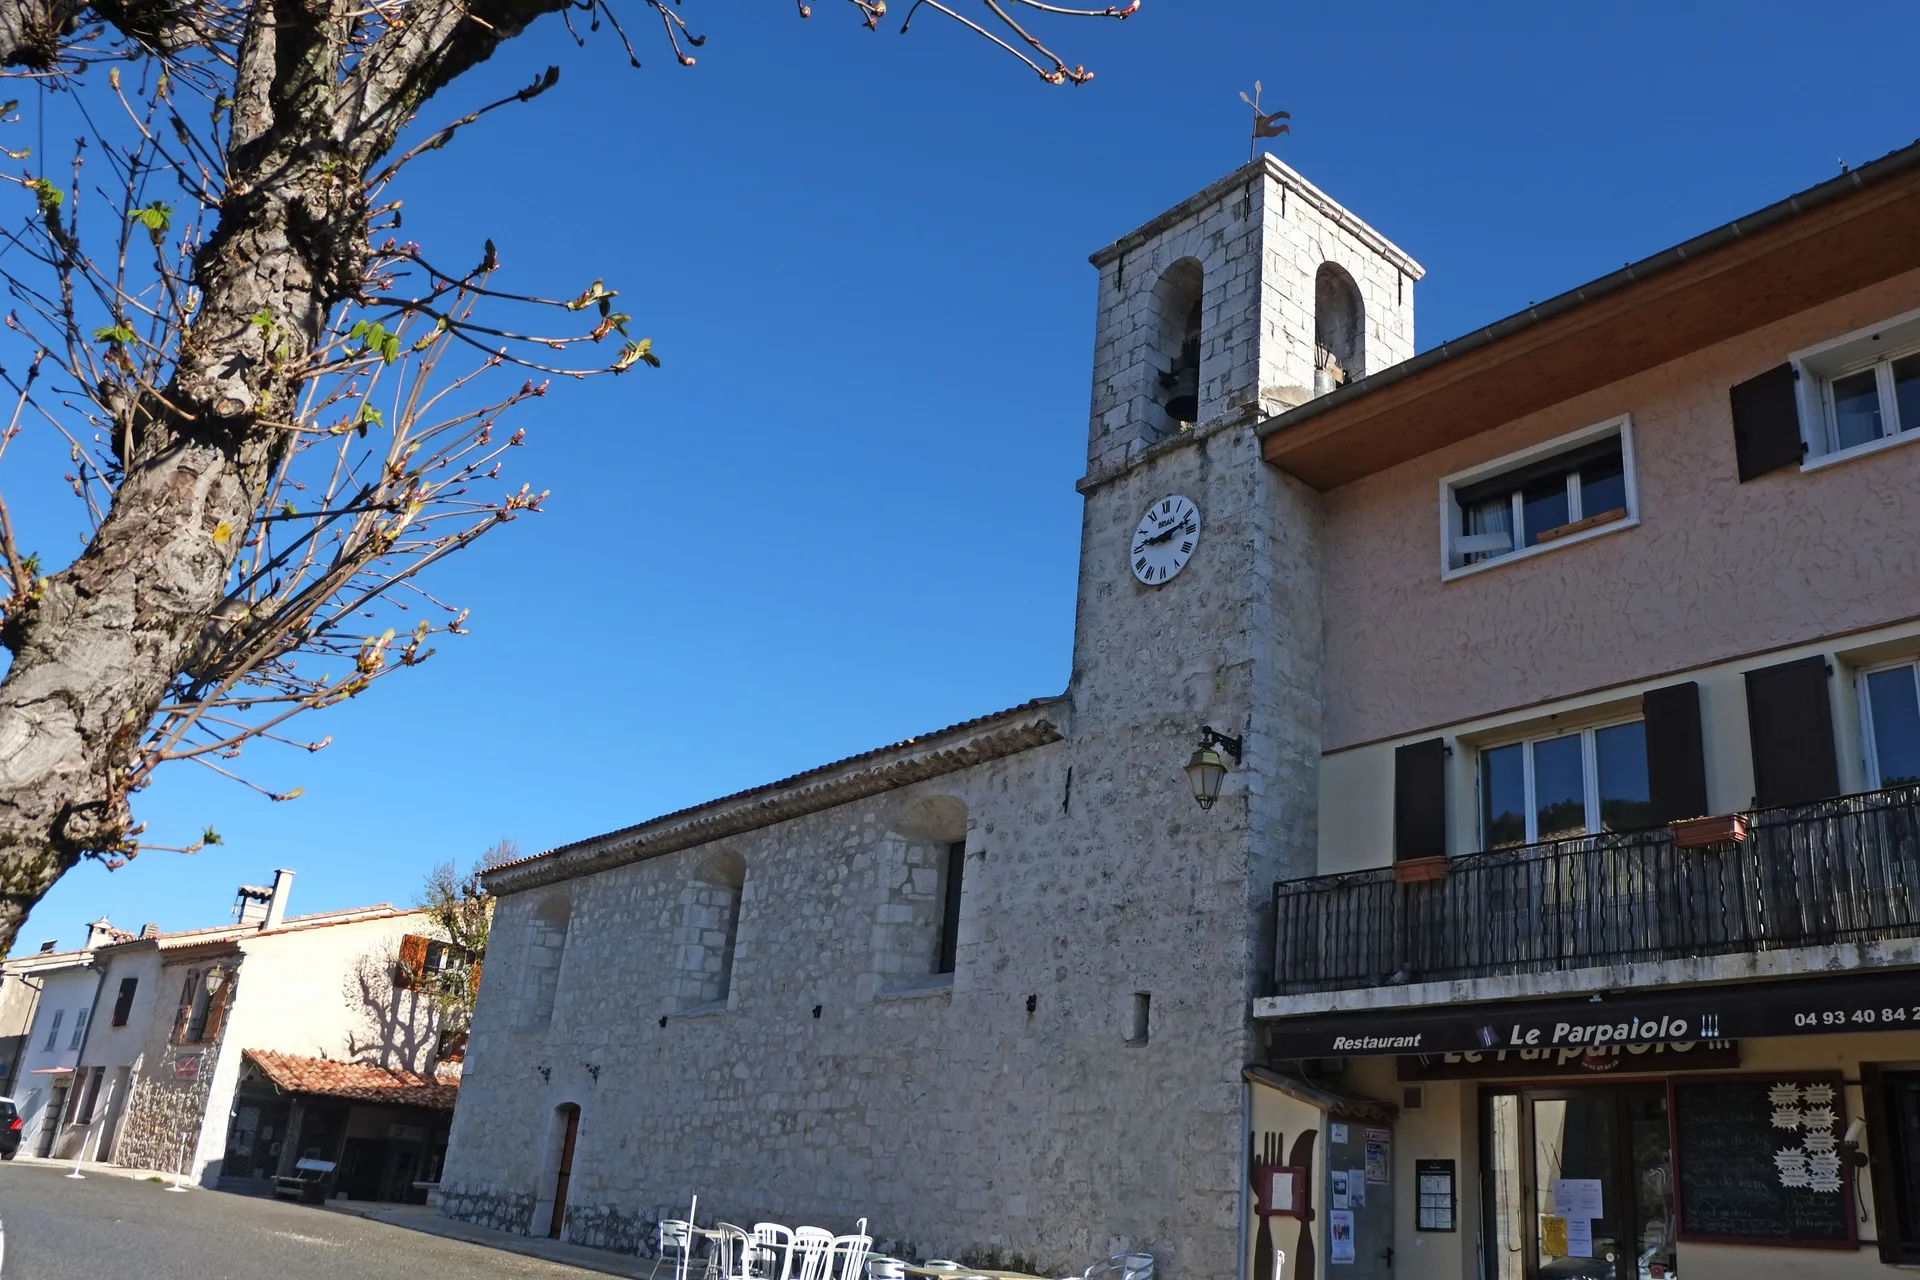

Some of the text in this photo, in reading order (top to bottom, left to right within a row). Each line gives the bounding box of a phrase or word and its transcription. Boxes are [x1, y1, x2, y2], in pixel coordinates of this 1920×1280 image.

[1794, 1012, 1817, 1027] 04
[1822, 1010, 1846, 1025] 93
[1851, 1009, 1875, 1023] 40
[1881, 1007, 1906, 1022] 84
[1510, 1015, 1688, 1046] Le Parpaiolo
[1332, 1033, 1422, 1050] Restaurant
